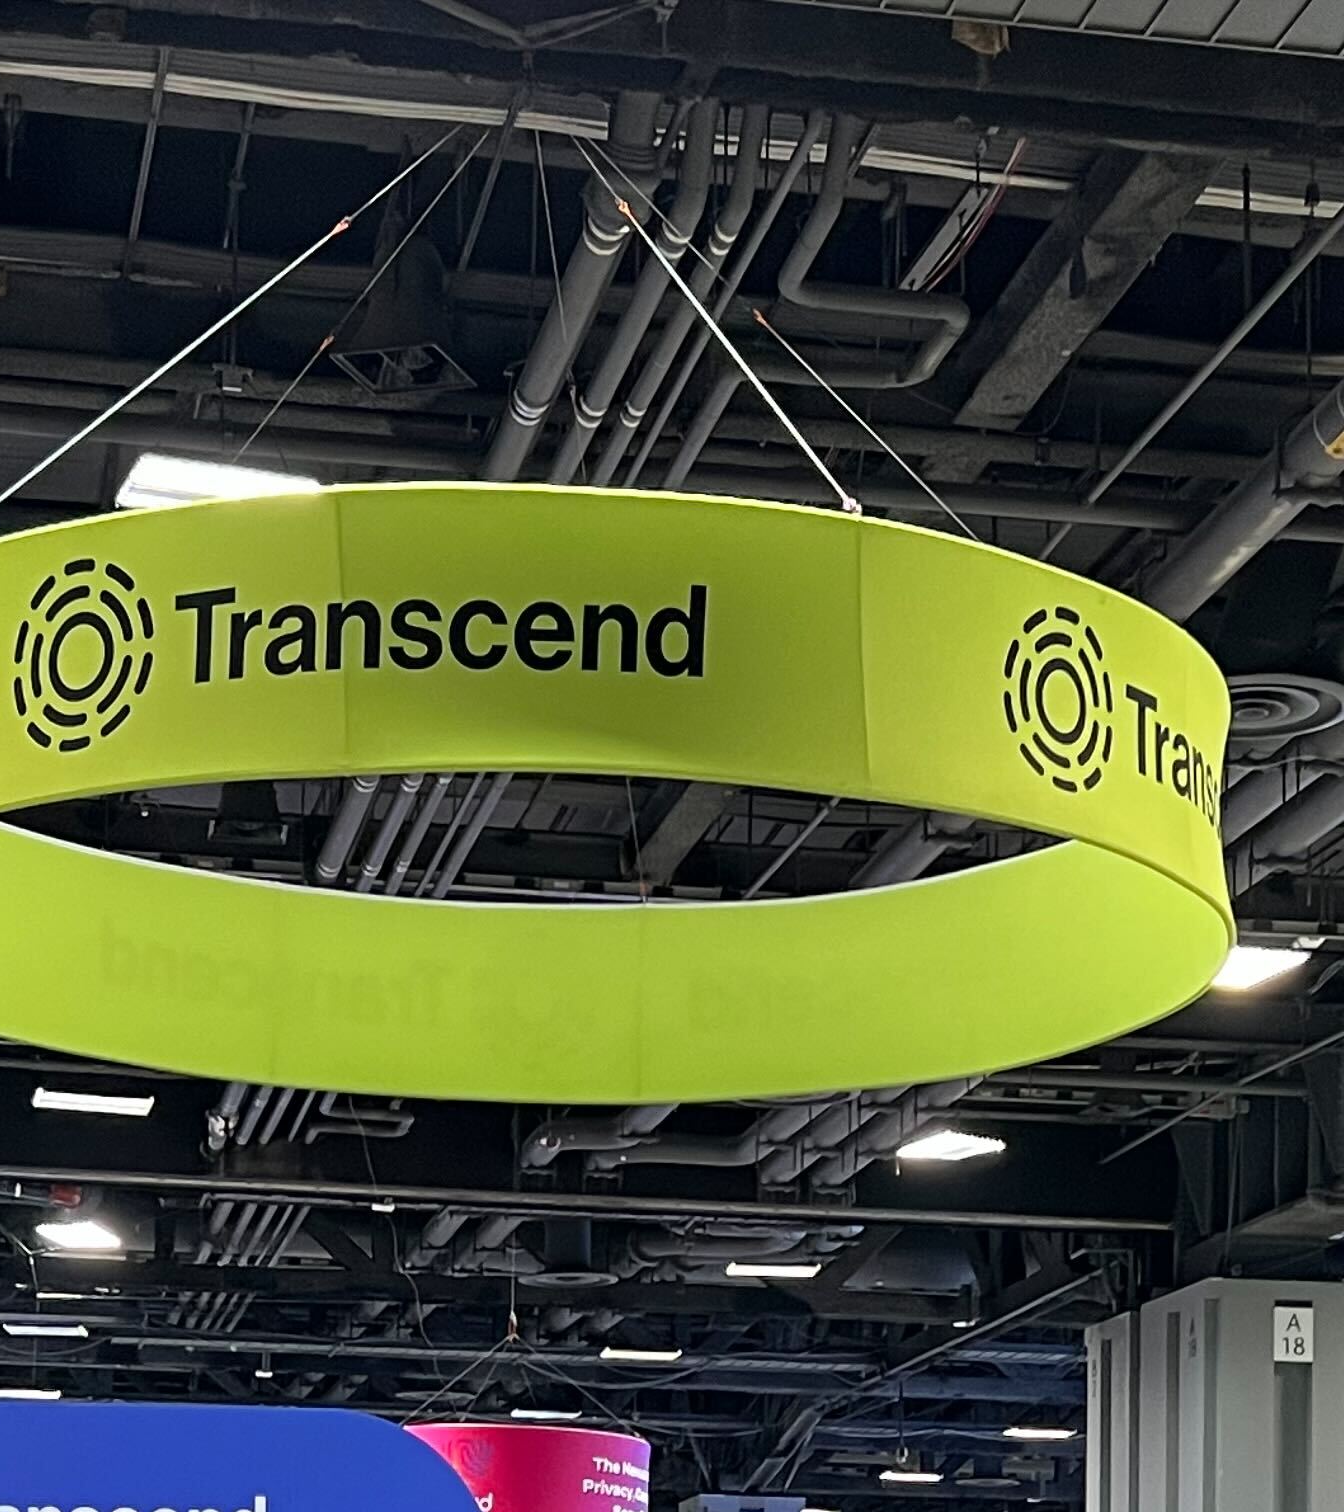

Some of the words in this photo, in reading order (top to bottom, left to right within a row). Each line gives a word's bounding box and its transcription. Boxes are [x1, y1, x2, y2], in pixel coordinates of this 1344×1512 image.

[175, 585, 707, 684] Transcend
[1286, 1313, 1301, 1332] A
[1282, 1336, 1305, 1356] 18
[593, 1457, 621, 1475] The
